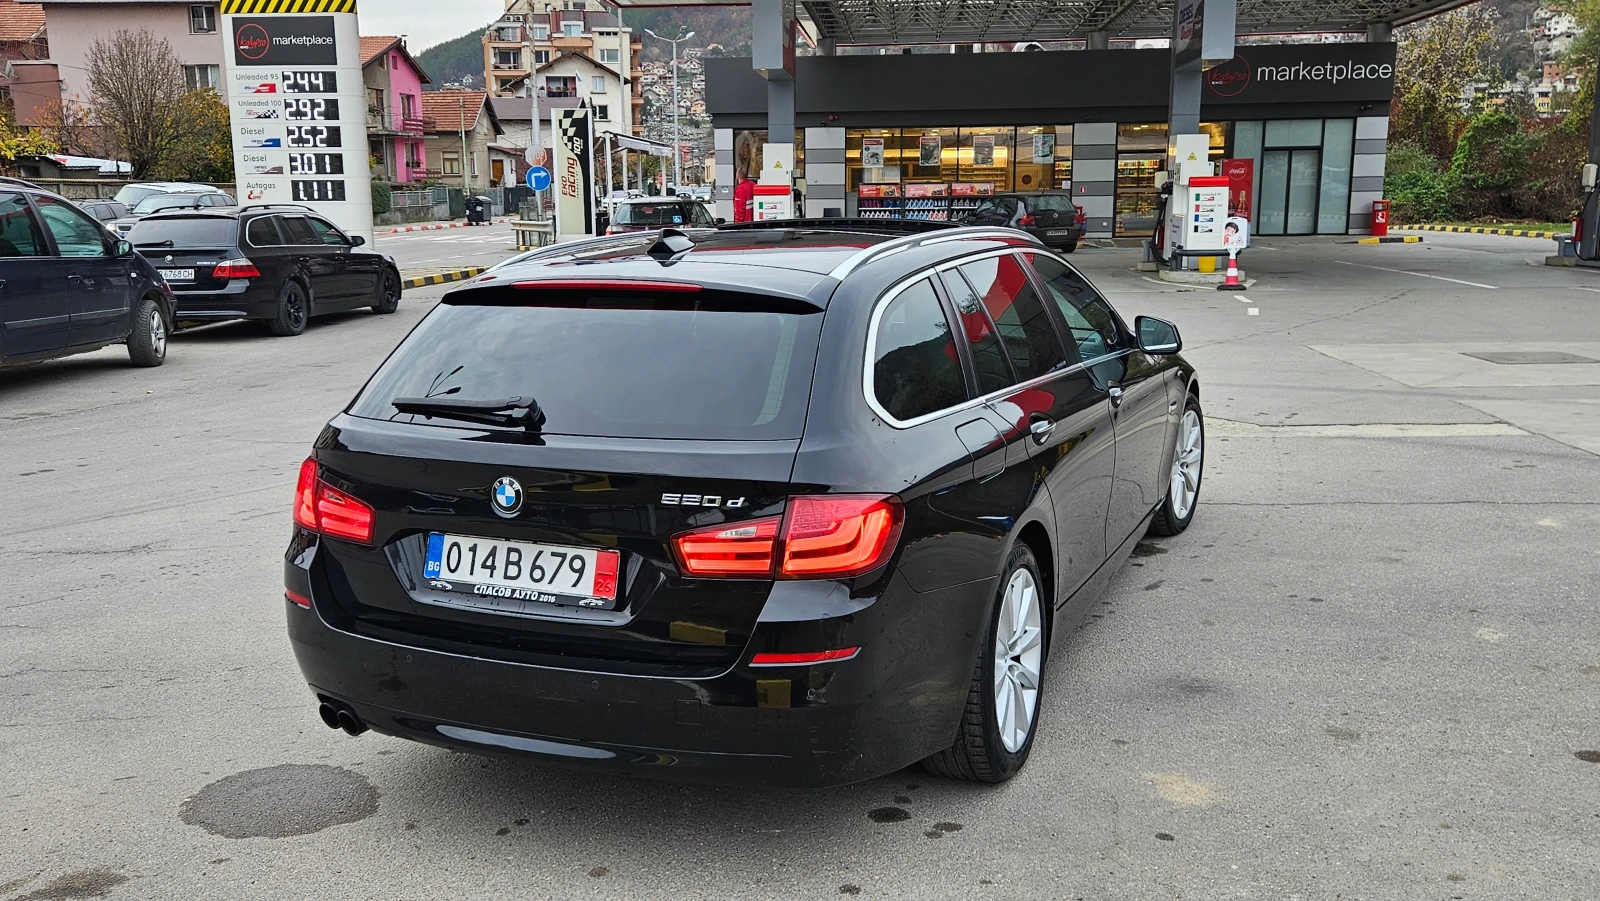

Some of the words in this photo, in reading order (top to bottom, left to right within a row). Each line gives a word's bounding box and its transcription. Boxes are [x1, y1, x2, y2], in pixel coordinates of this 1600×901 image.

[272, 34, 334, 46] marketplace
[1256, 60, 1393, 84] marketplace
[235, 73, 269, 81] Unleaded
[282, 71, 324, 94] 2.44
[285, 98, 326, 121] 2.92
[240, 127, 265, 135] Diesel
[287, 126, 328, 148] 2.52
[573, 136, 582, 155] 100
[243, 154, 267, 162] Diesel
[290, 153, 331, 175] 3.01
[246, 182, 276, 191] Autogas
[566, 156, 578, 198] racing
[493, 477, 520, 491] BMW
[427, 560, 440, 572] BG
[473, 584, 512, 599] СПАСОВ
[512, 588, 539, 602] АУТО
[539, 594, 556, 604] 2016
[596, 580, 612, 594] 26
